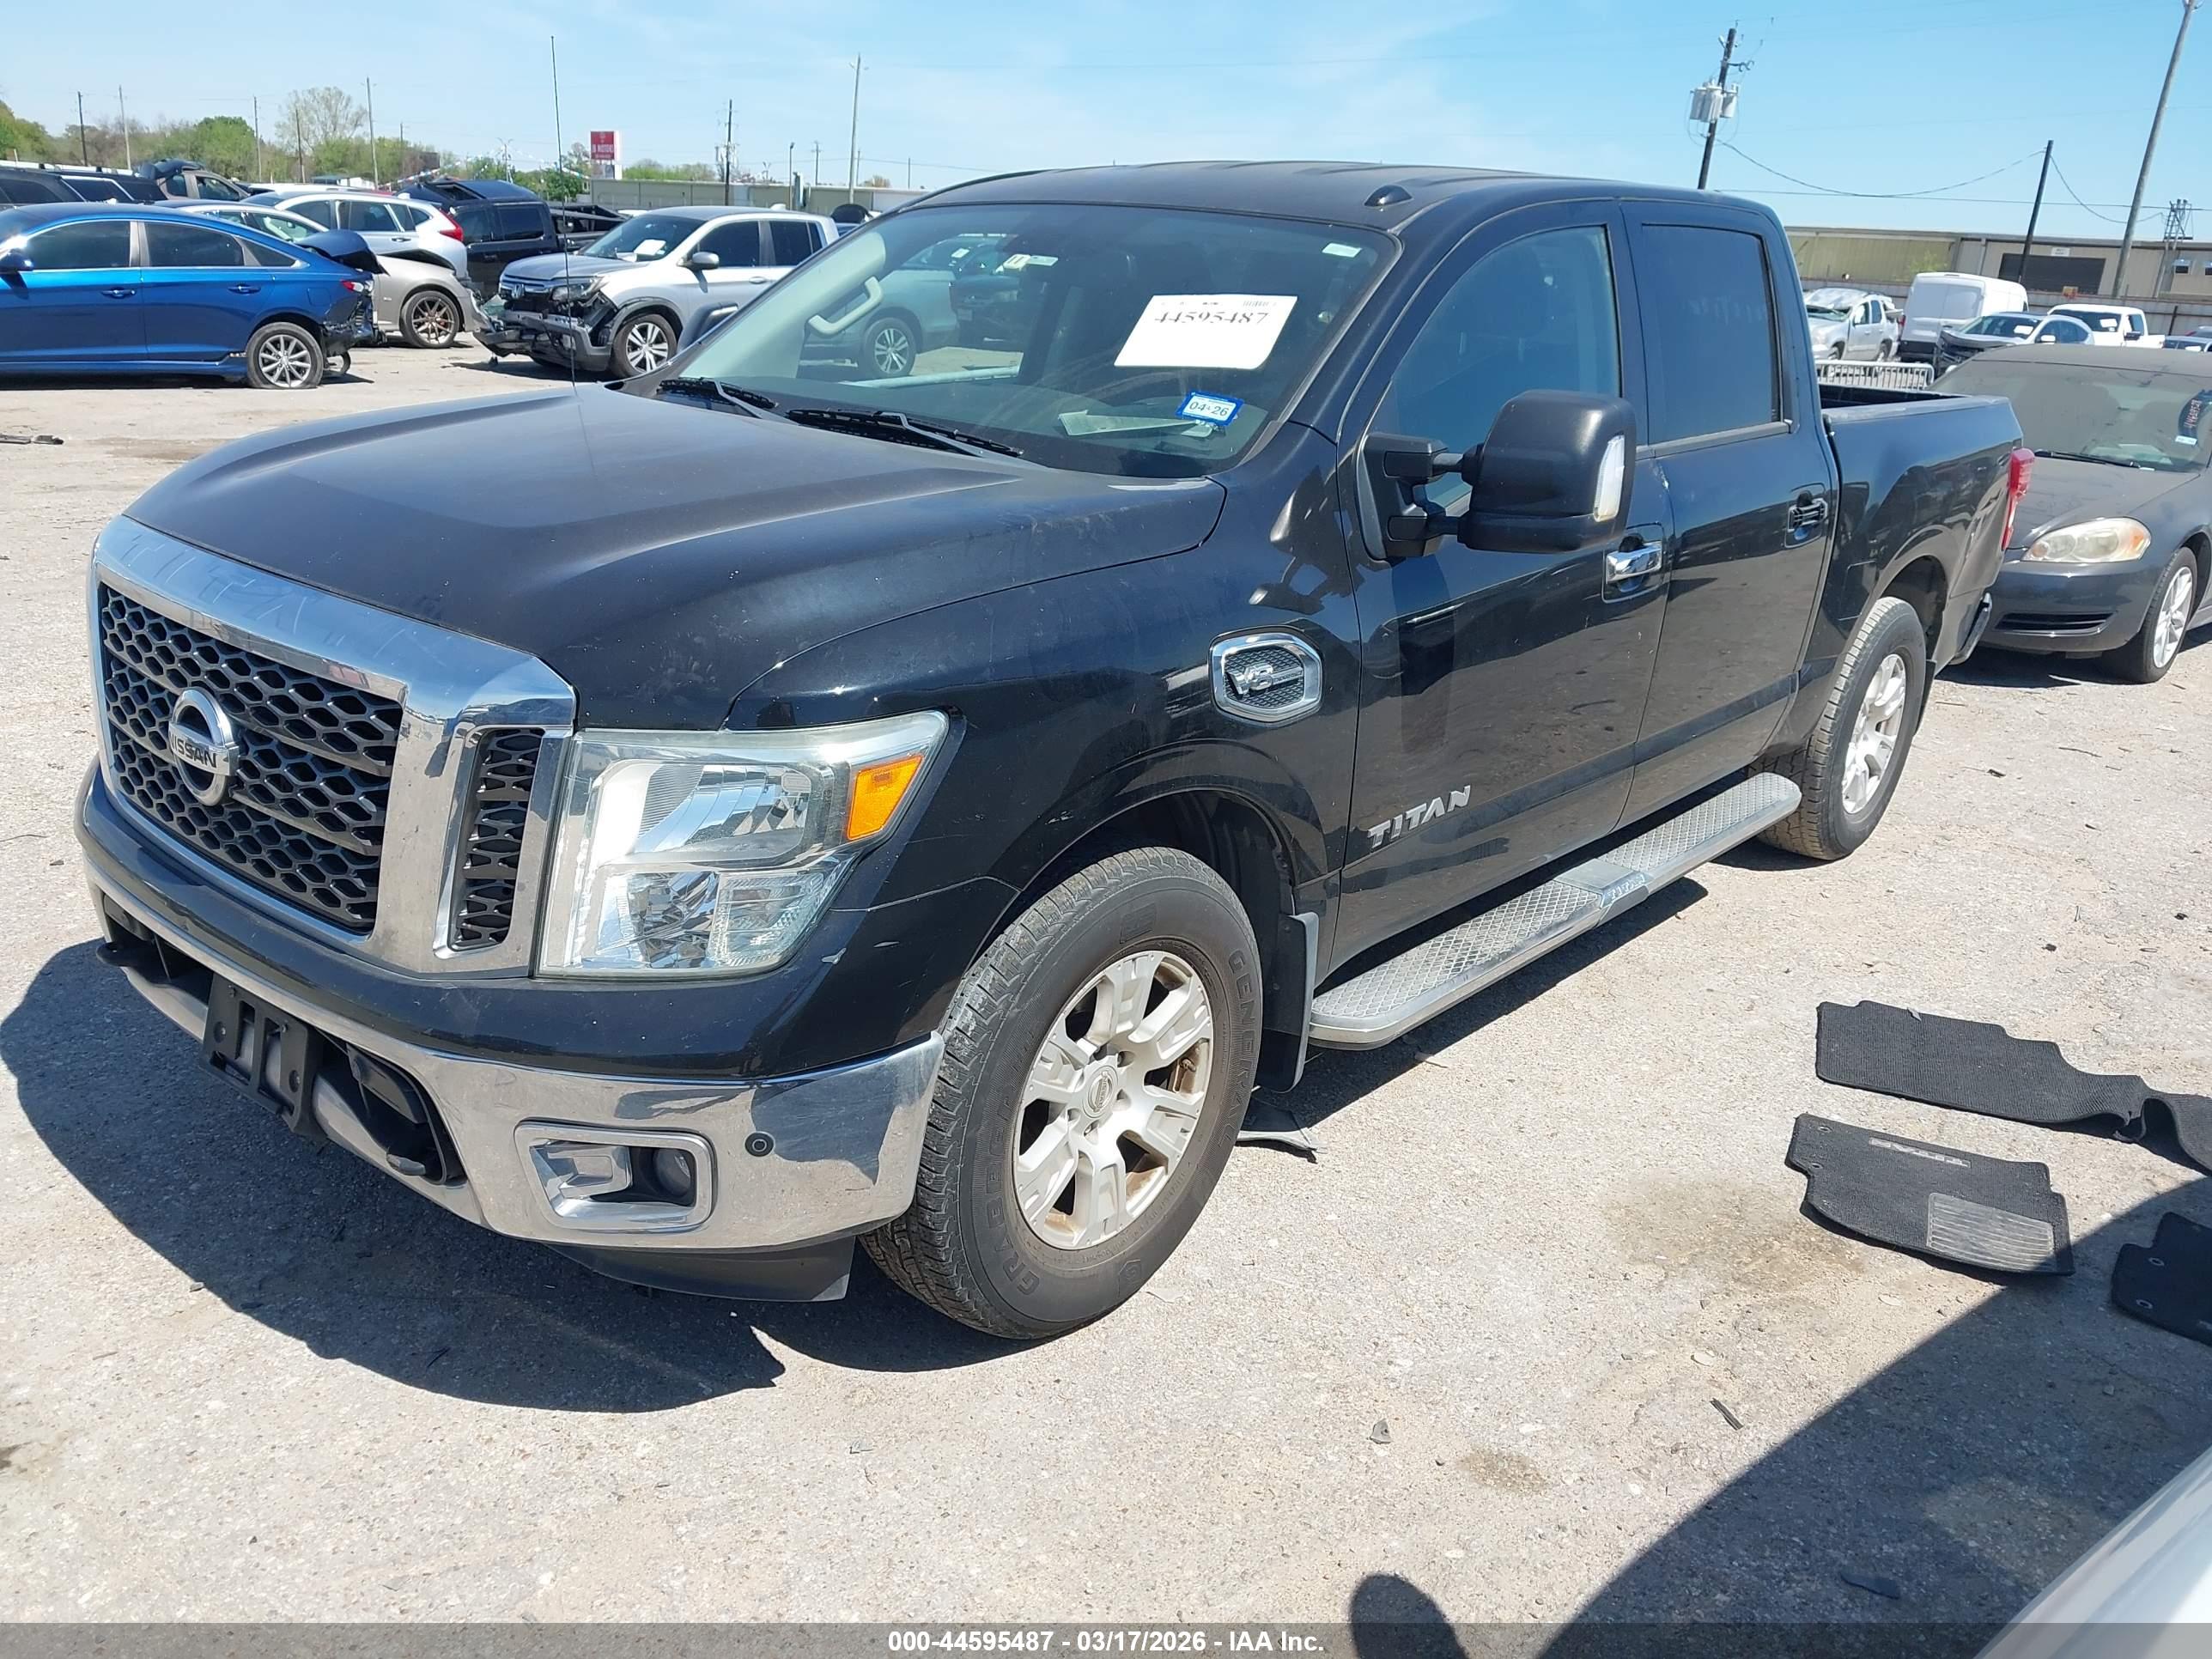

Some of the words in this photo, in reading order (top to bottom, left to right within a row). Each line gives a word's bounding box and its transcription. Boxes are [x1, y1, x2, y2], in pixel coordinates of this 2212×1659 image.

[1154, 311, 1269, 324] 44595487
[1189, 401, 1206, 411] 04
[1210, 405, 1230, 416] 26
[171, 734, 217, 769] NISSAN
[1367, 784, 1471, 849] TITAN
